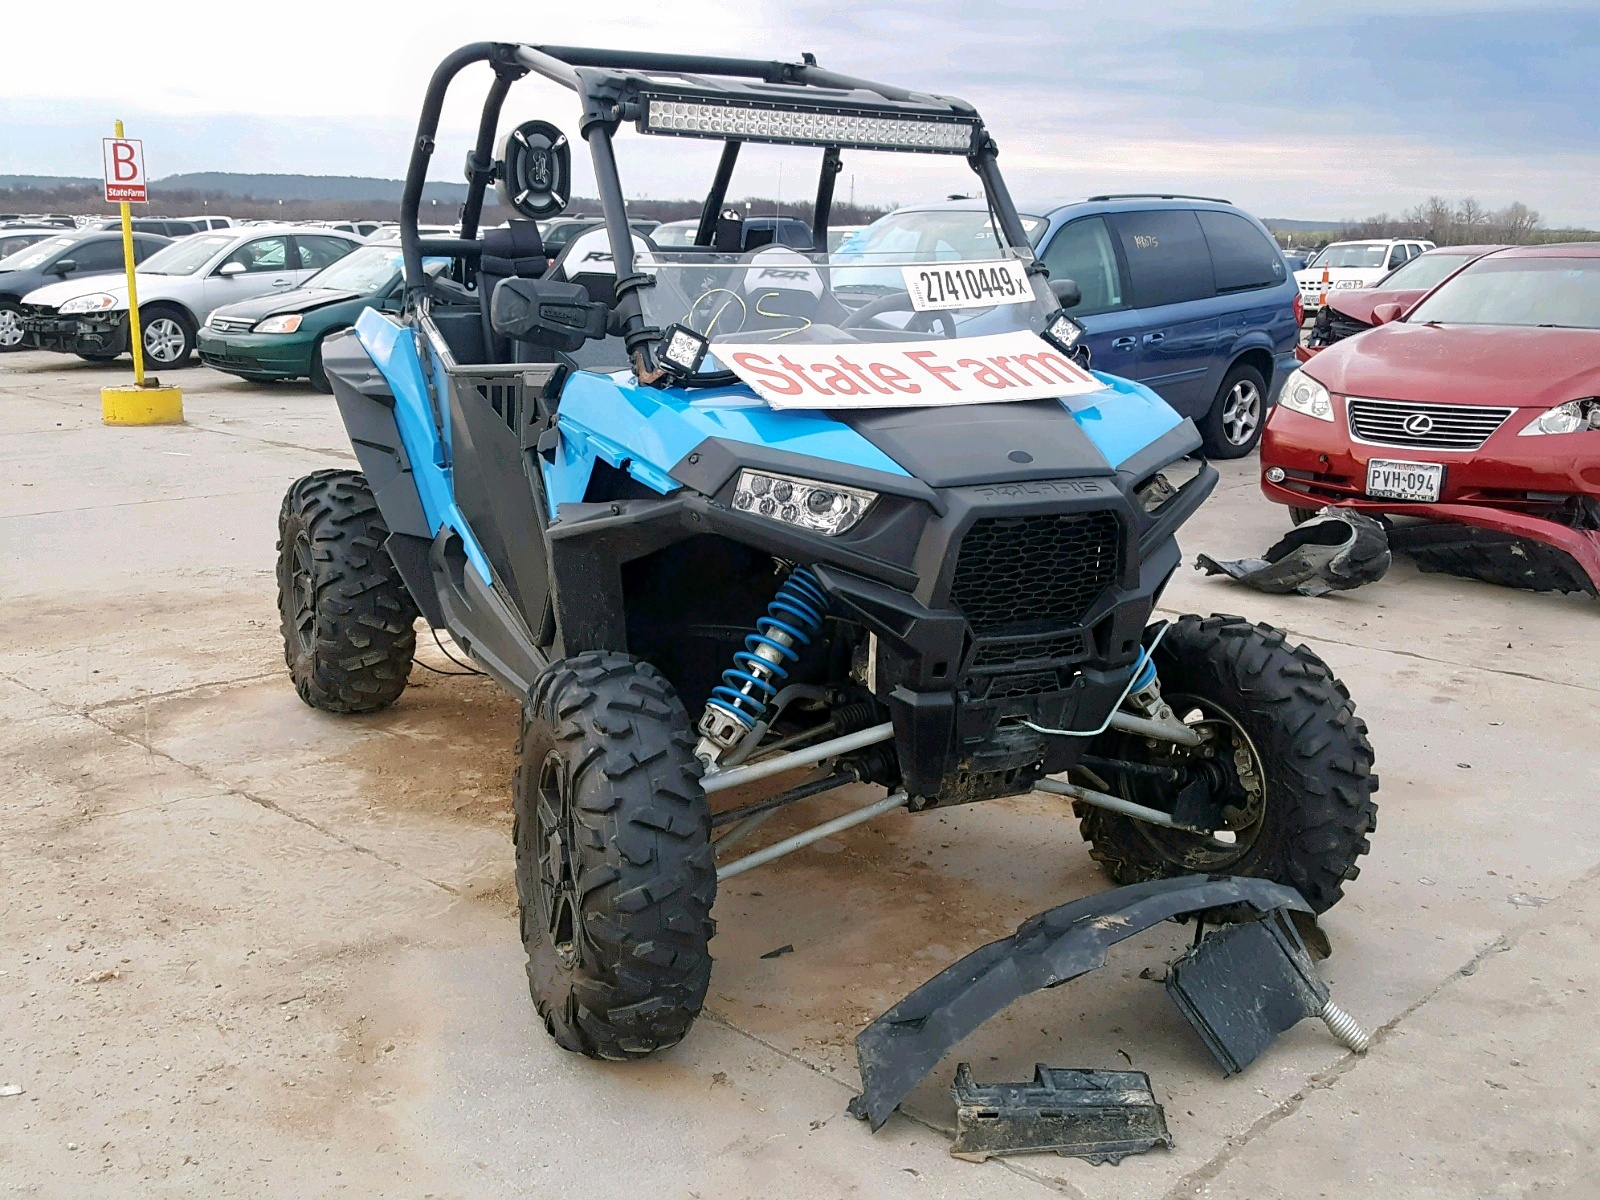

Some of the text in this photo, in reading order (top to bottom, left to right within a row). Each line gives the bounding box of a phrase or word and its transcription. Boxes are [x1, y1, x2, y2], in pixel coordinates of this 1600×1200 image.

[113, 143, 137, 181] B
[758, 268, 811, 281] RZR
[732, 350, 1092, 395] State Farm
[975, 481, 1103, 500] POLARIS
